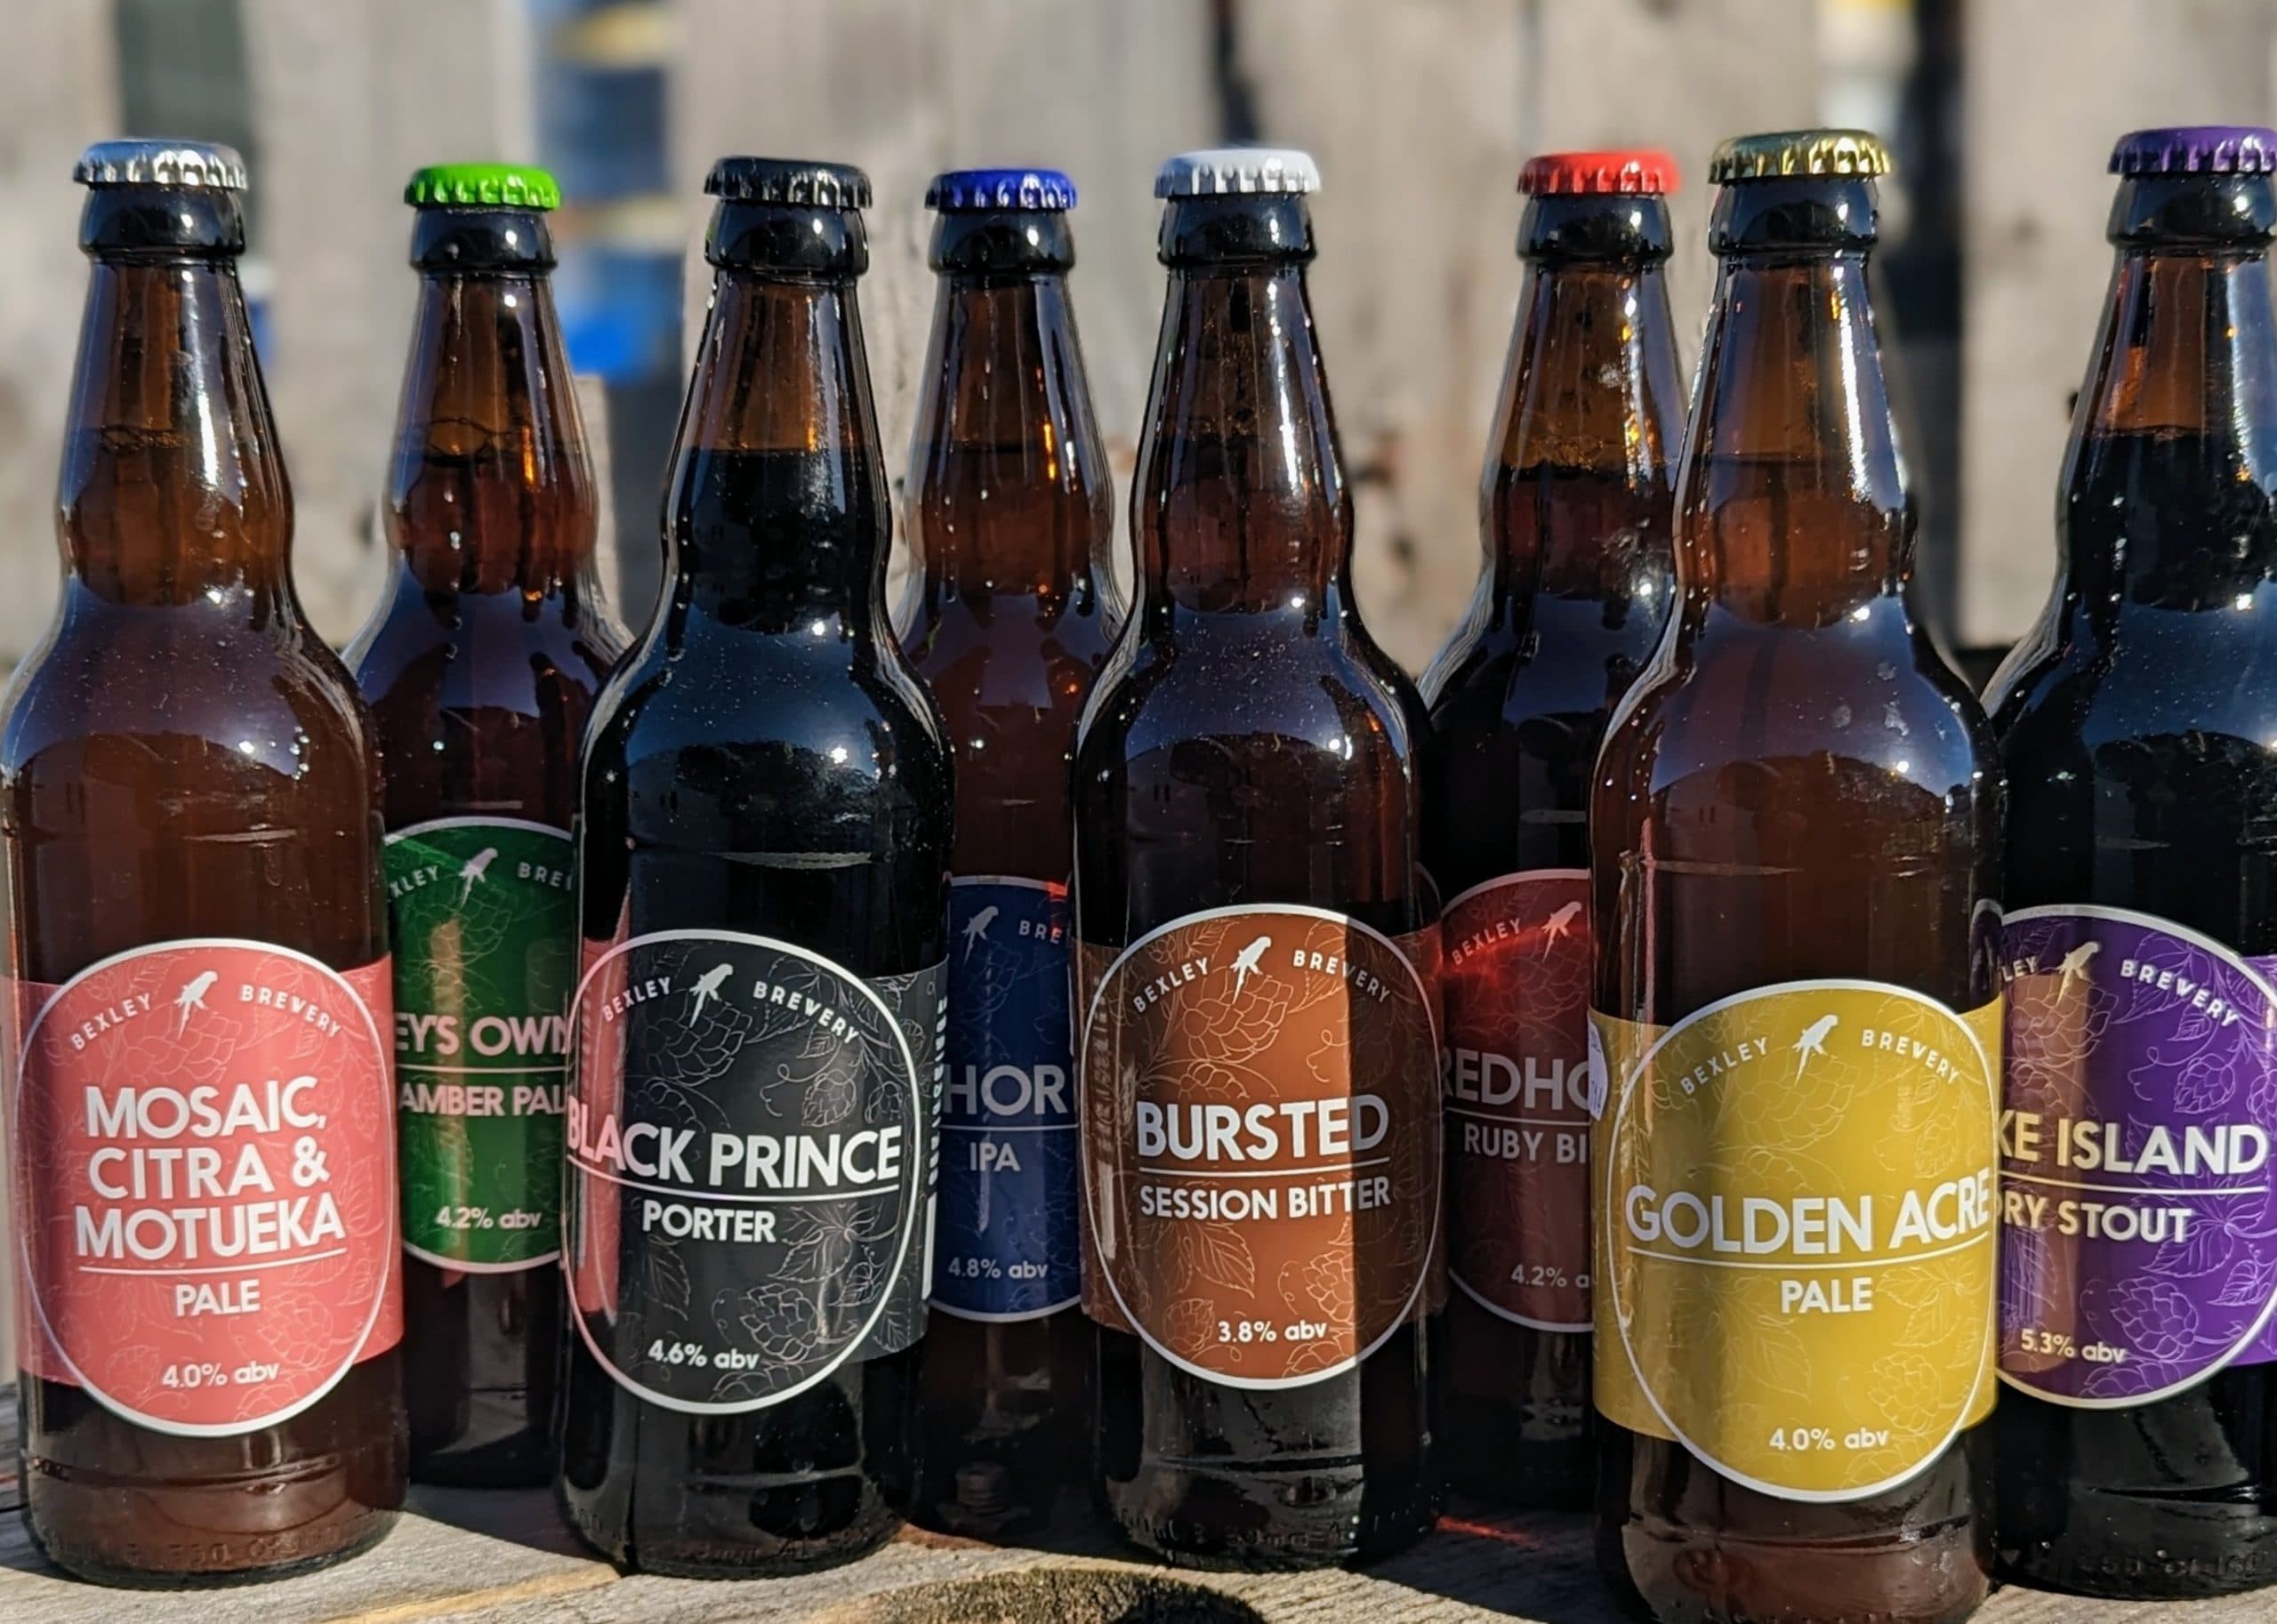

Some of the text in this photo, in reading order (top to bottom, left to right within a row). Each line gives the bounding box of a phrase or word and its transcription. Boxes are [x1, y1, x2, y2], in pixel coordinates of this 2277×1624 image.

[1018, 920, 1063, 945] BRE
[1451, 917, 1522, 967] BEXLEY
[1131, 950, 1392, 1014] BEXLEY BREWERY
[2120, 959, 2241, 1027] BREWERY
[70, 984, 342, 1051] BEXLEY BREWERY
[602, 976, 860, 1045] BEXLEY BREWERY
[1679, 1028, 1960, 1096] BEXLEY BREWERY
[85, 1075, 326, 1138] MOSAIC,
[399, 1081, 505, 1116] AMBER
[944, 1064, 1068, 1116] HOR
[567, 1095, 901, 1190] BLACK PRINCE
[1137, 1094, 1389, 1162] BURSTED
[1464, 1122, 1587, 1163] RUBY BI
[2056, 1116, 2270, 1177] ISLAND
[88, 1137, 331, 1201] CITRA &
[970, 1142, 1021, 1172] IPA
[435, 1206, 542, 1229] 4.2% abv
[1139, 1176, 1391, 1221] SESSION BITTER
[1625, 1166, 1991, 1255] GOLDEN ACRE
[1997, 1190, 2193, 1244] RY STOUT
[75, 1193, 346, 1261] MOTUEKA
[642, 1204, 776, 1243] PORTER
[947, 1257, 1049, 1280] 4.8% abv
[1510, 1264, 1567, 1287] 4.2%
[174, 1280, 260, 1317] PALE
[1780, 1277, 1873, 1314] PALE
[1217, 1320, 1327, 1343] 3.8% abv
[2020, 1328, 2128, 1365] 5.3% abv
[162, 1361, 280, 1388] 4.0% abv
[648, 1339, 760, 1371] 4.6% abv
[1769, 1427, 1889, 1451] 4.0% abv
